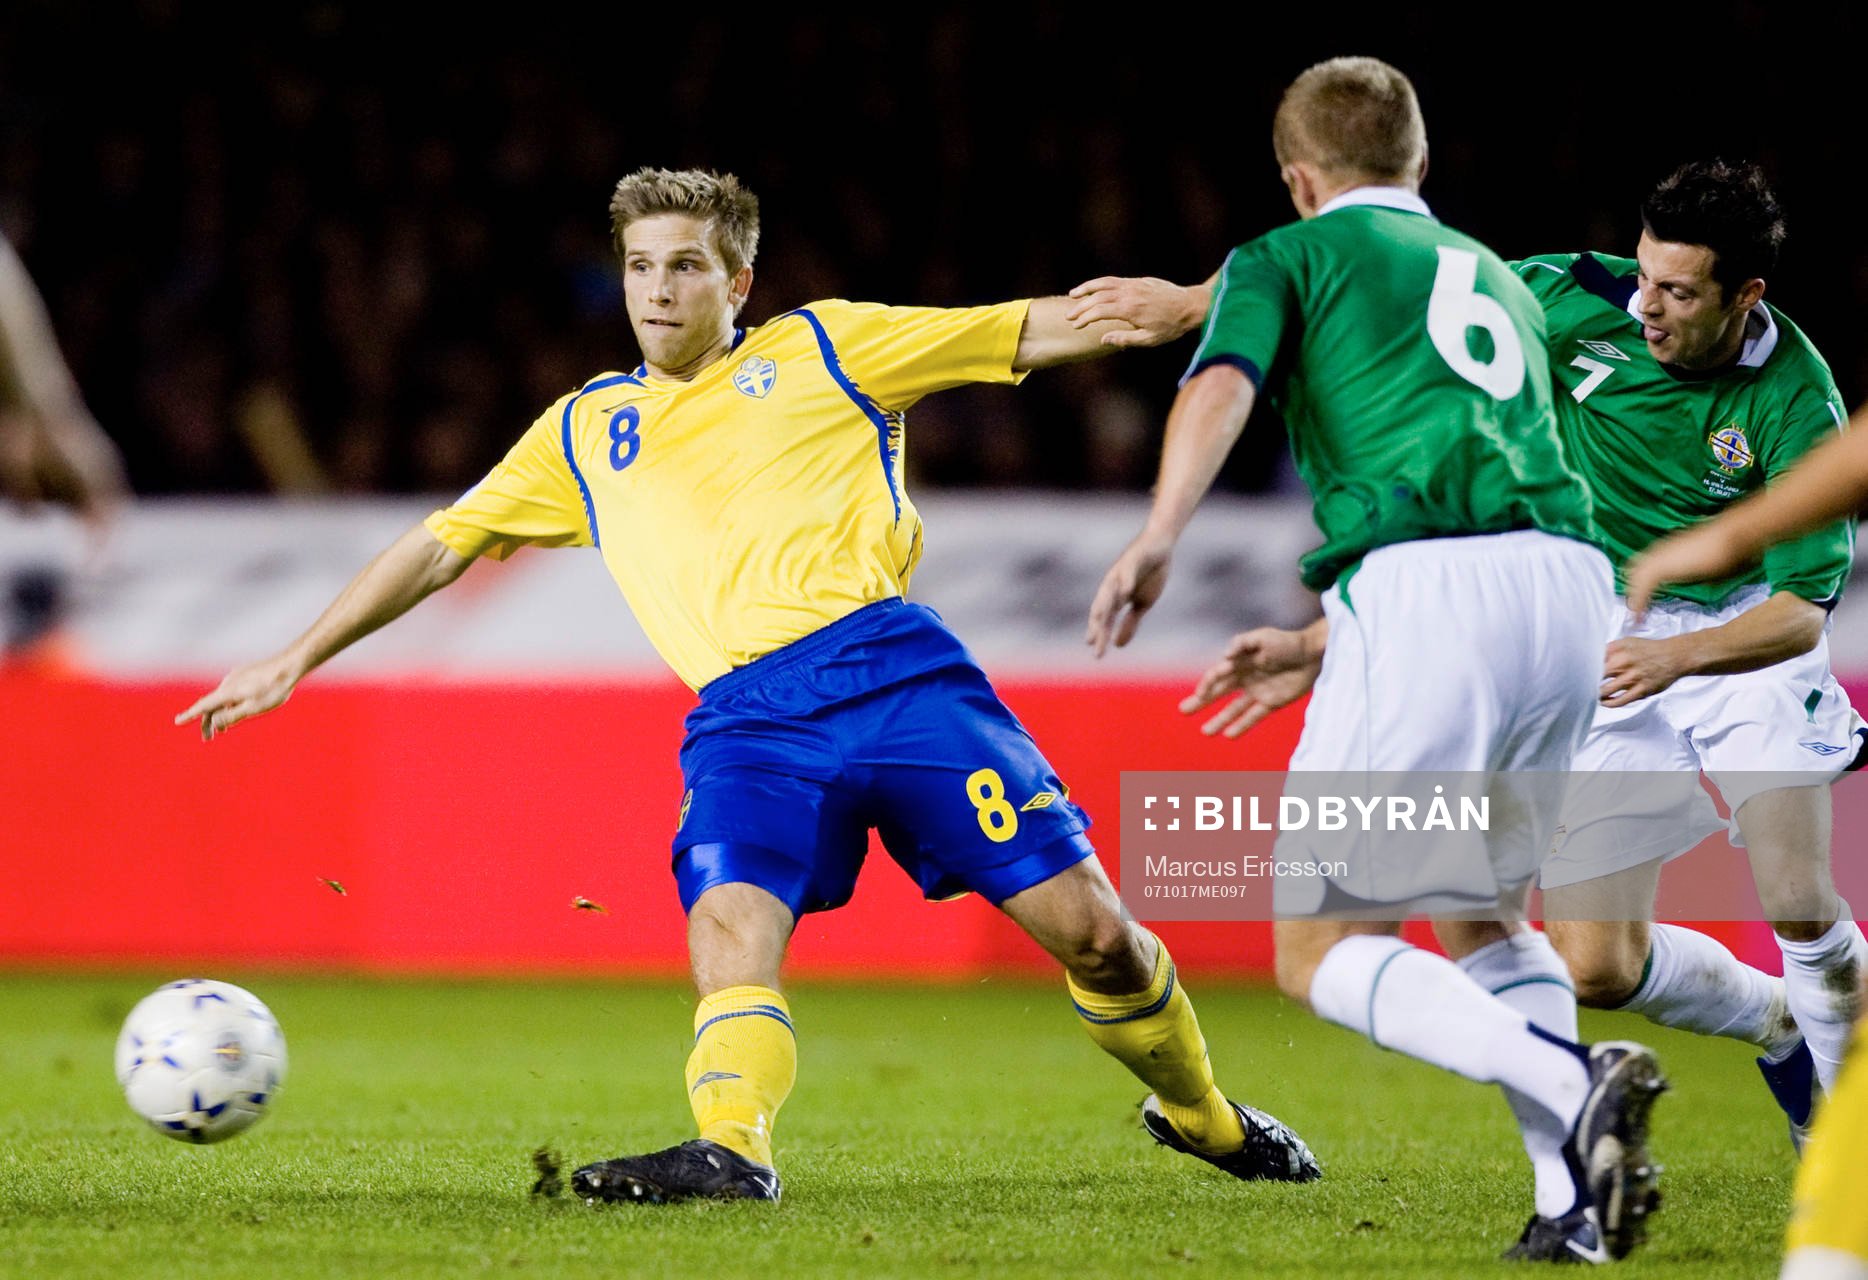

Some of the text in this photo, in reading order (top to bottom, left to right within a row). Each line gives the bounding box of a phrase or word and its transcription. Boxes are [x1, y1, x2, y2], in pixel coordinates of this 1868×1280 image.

[1426, 244, 1526, 401] 6
[1570, 354, 1616, 404] 7
[609, 406, 641, 471] 8
[965, 768, 1019, 843] 8
